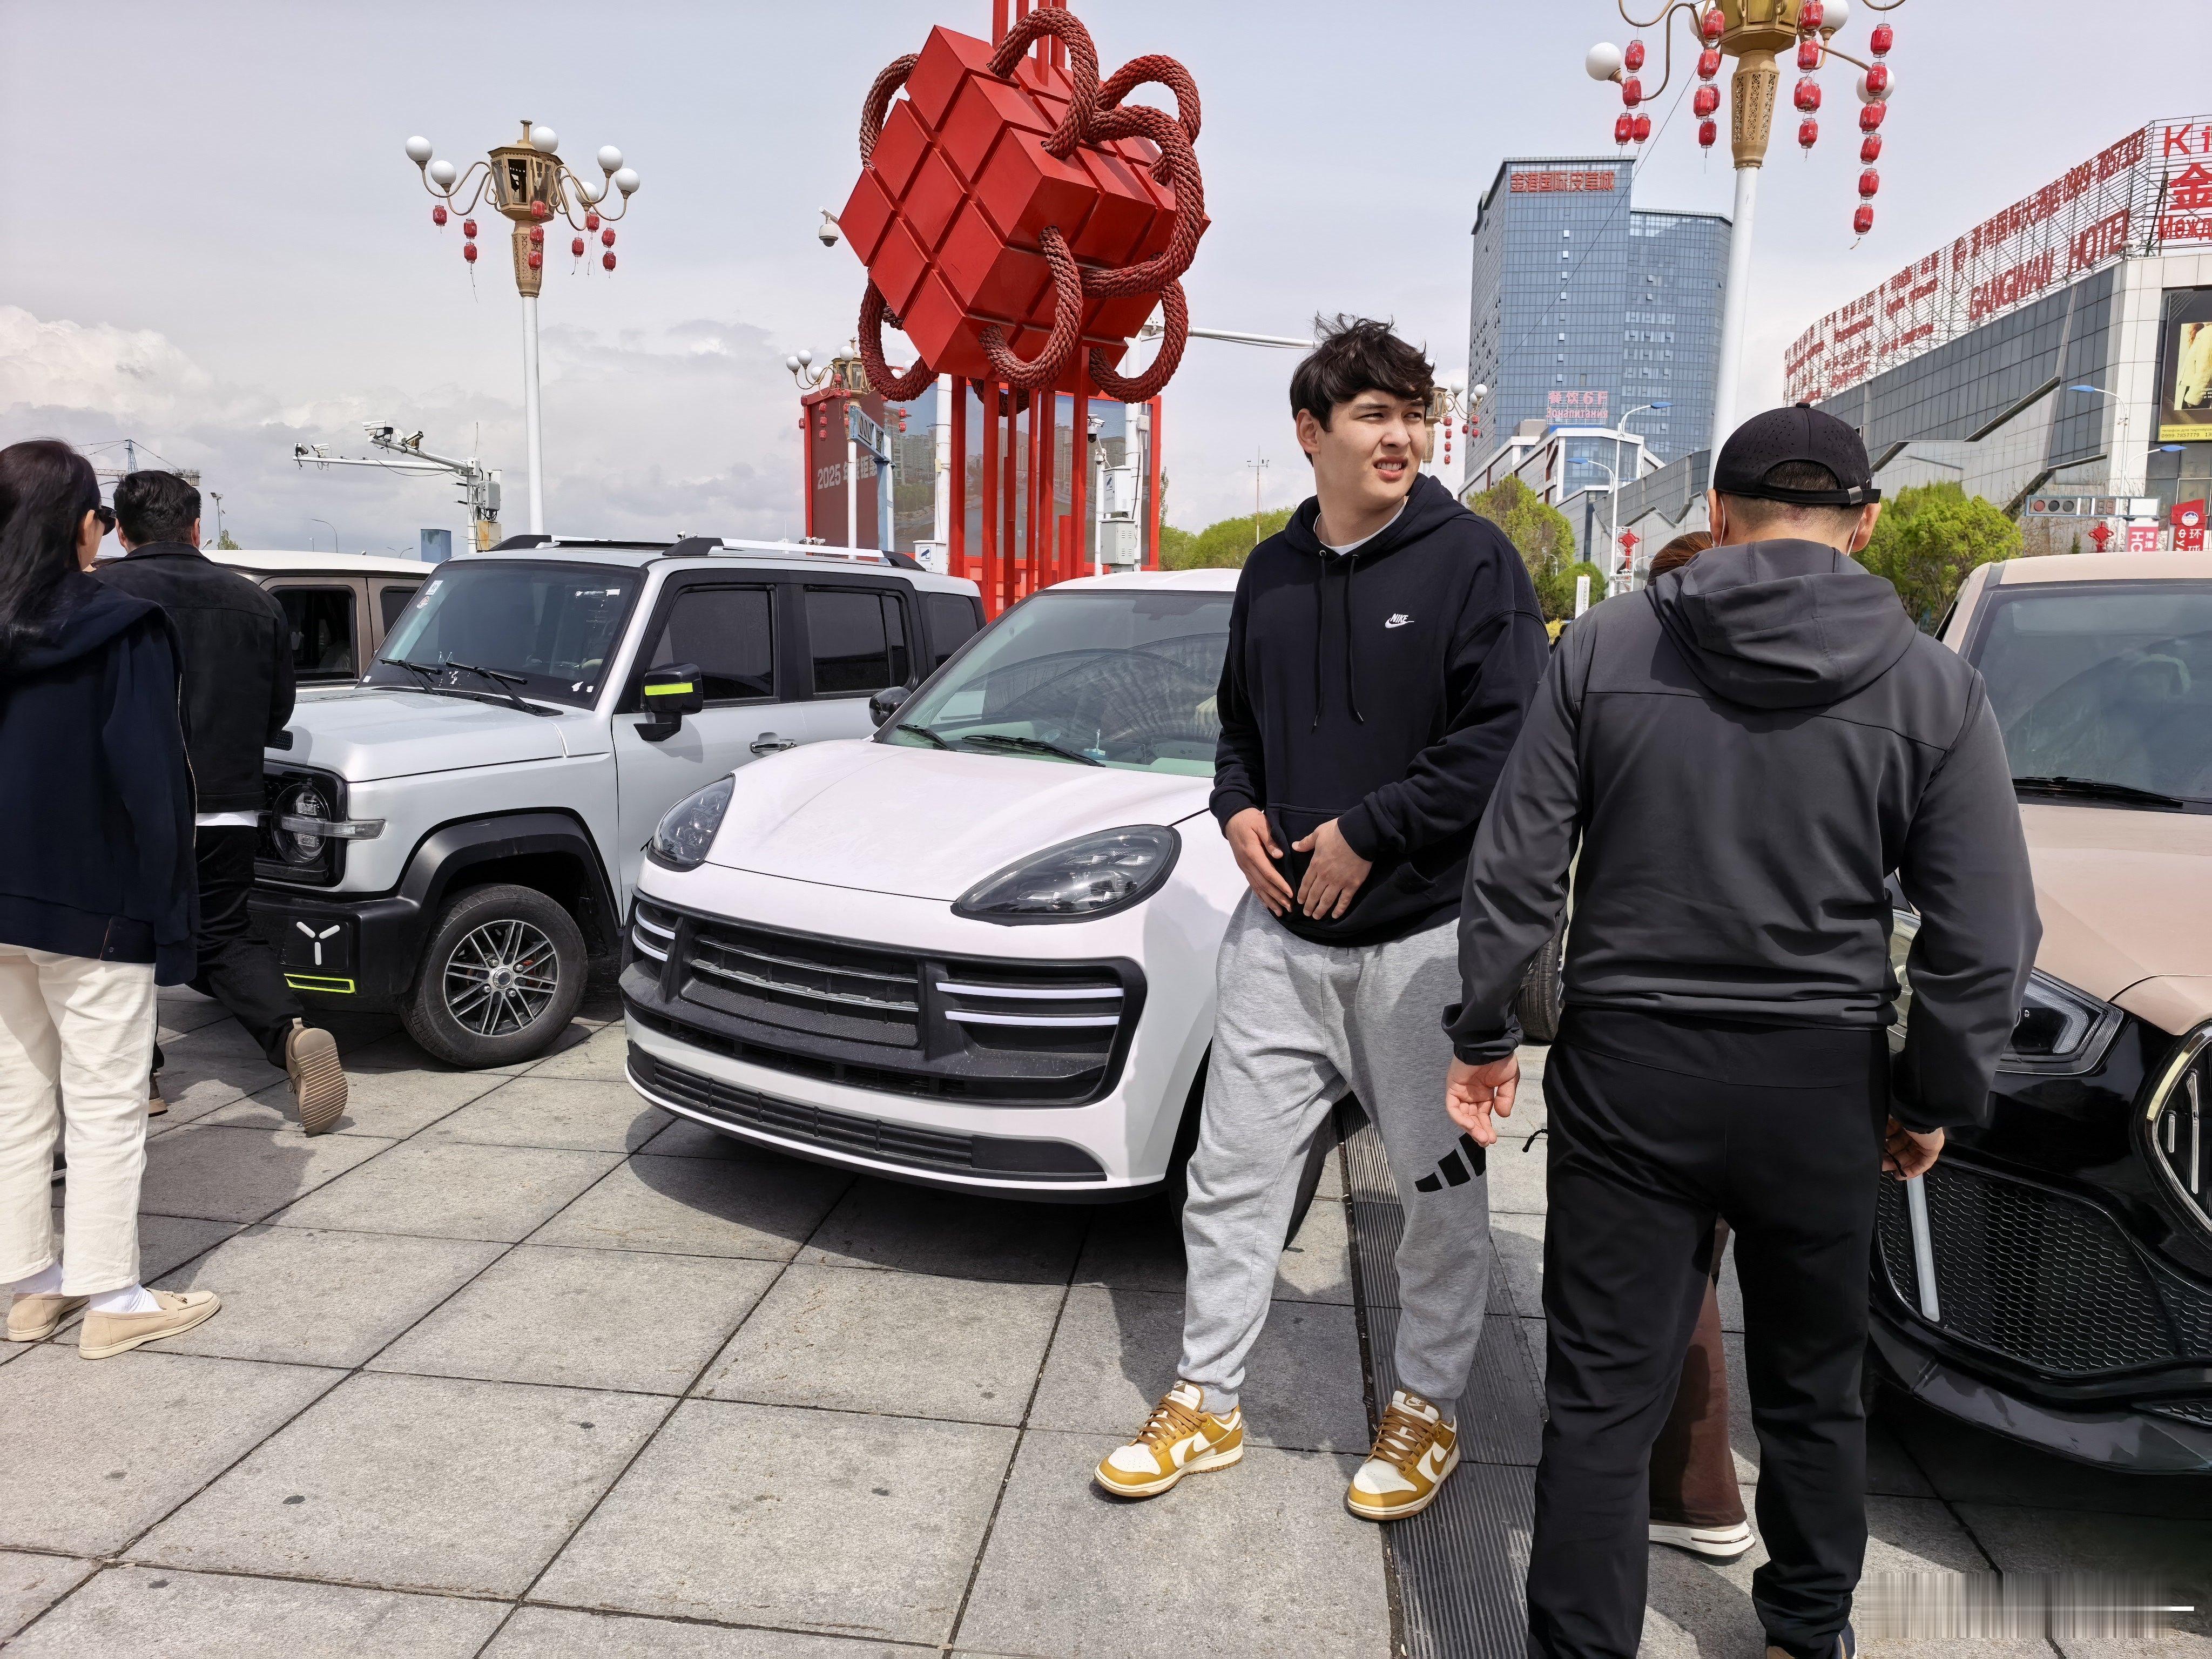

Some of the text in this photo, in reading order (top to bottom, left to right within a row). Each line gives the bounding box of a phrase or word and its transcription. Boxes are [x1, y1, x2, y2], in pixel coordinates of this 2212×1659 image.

[1969, 247, 2054, 321] GANGWAN
[2067, 207, 2130, 274] HOTEL
[817, 463, 841, 490] 2025
[1390, 613, 1409, 623] NIKE
